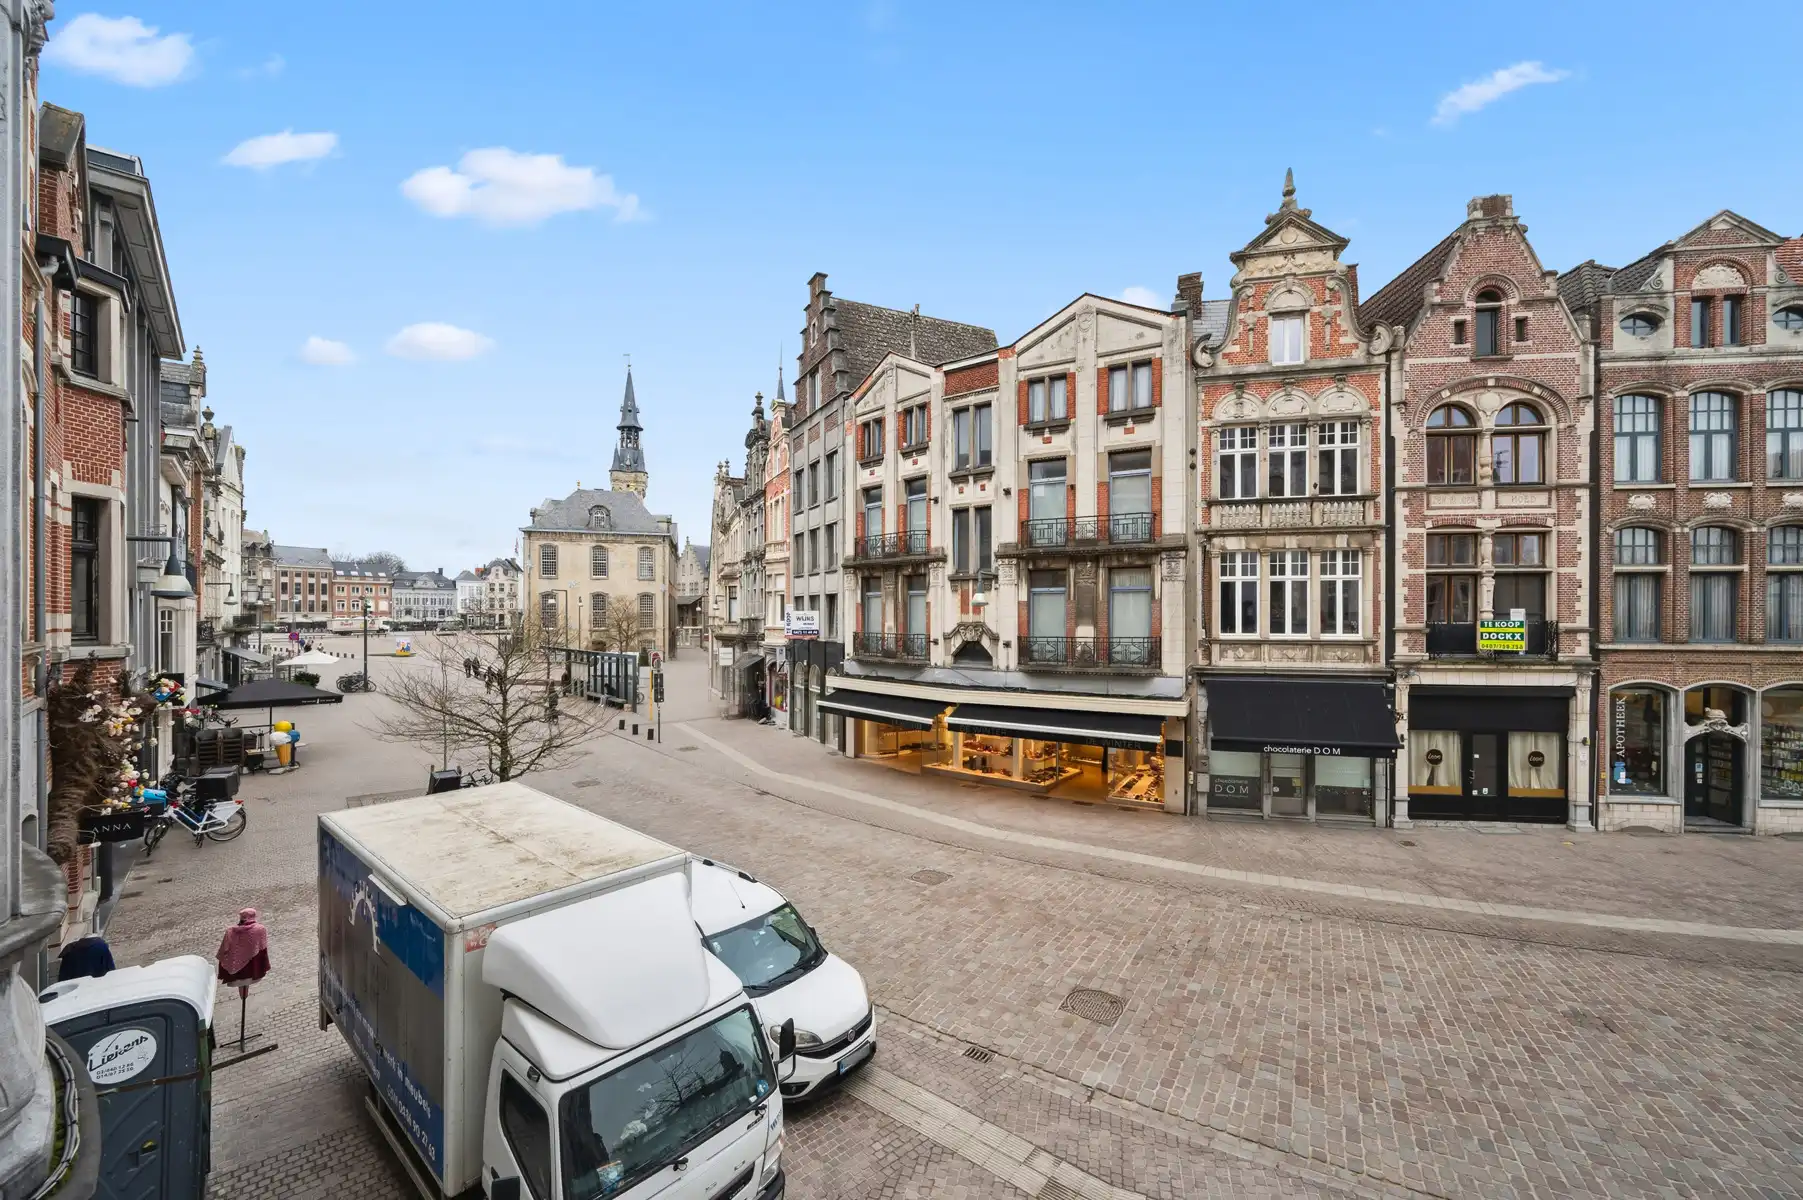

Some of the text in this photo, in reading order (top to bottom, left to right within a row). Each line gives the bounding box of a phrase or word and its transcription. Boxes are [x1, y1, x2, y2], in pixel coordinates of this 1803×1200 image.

[1482, 632, 1522, 640] DOCKX
[1616, 695, 1627, 758] APOTHEEK
[1263, 744, 1312, 755] chocolaterie
[92, 823, 132, 833] ANNA
